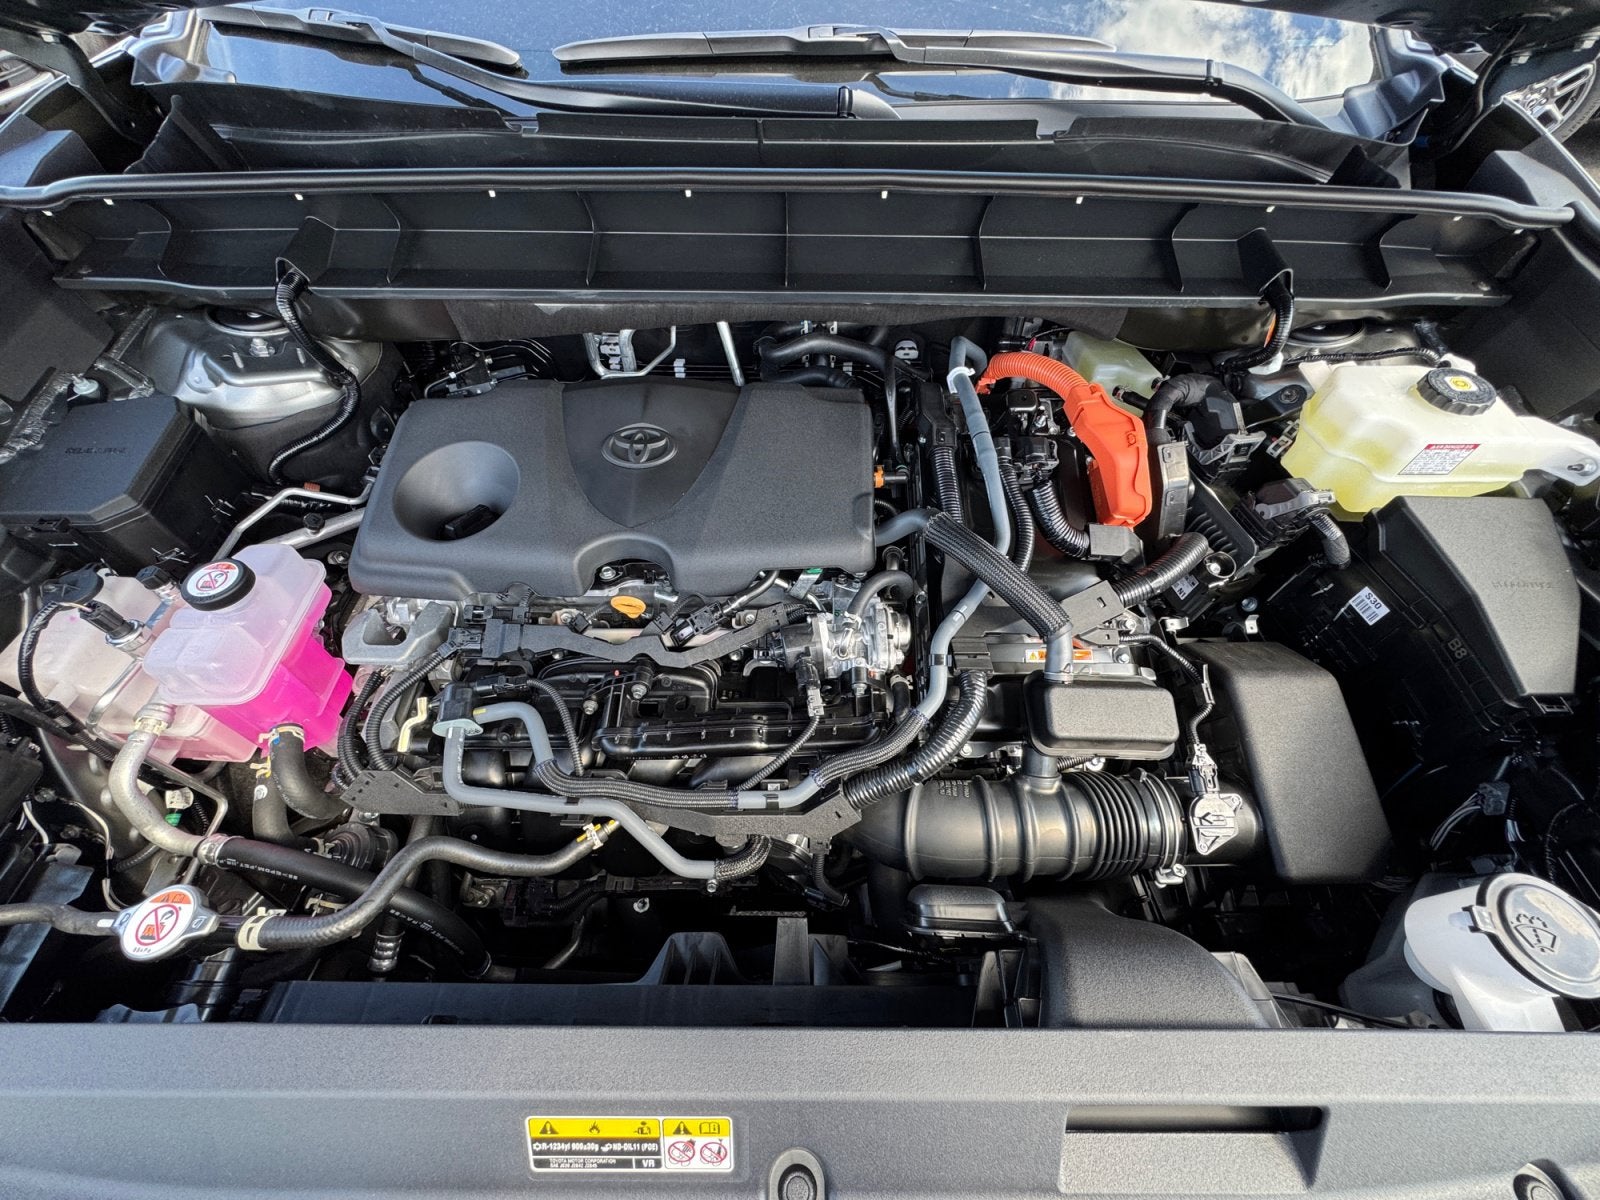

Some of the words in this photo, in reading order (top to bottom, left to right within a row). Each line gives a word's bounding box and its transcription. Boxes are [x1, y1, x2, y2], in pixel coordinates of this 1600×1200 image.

[1365, 592, 1382, 609] S30
[1447, 638, 1467, 659] B8
[642, 1159, 655, 1168] VR
